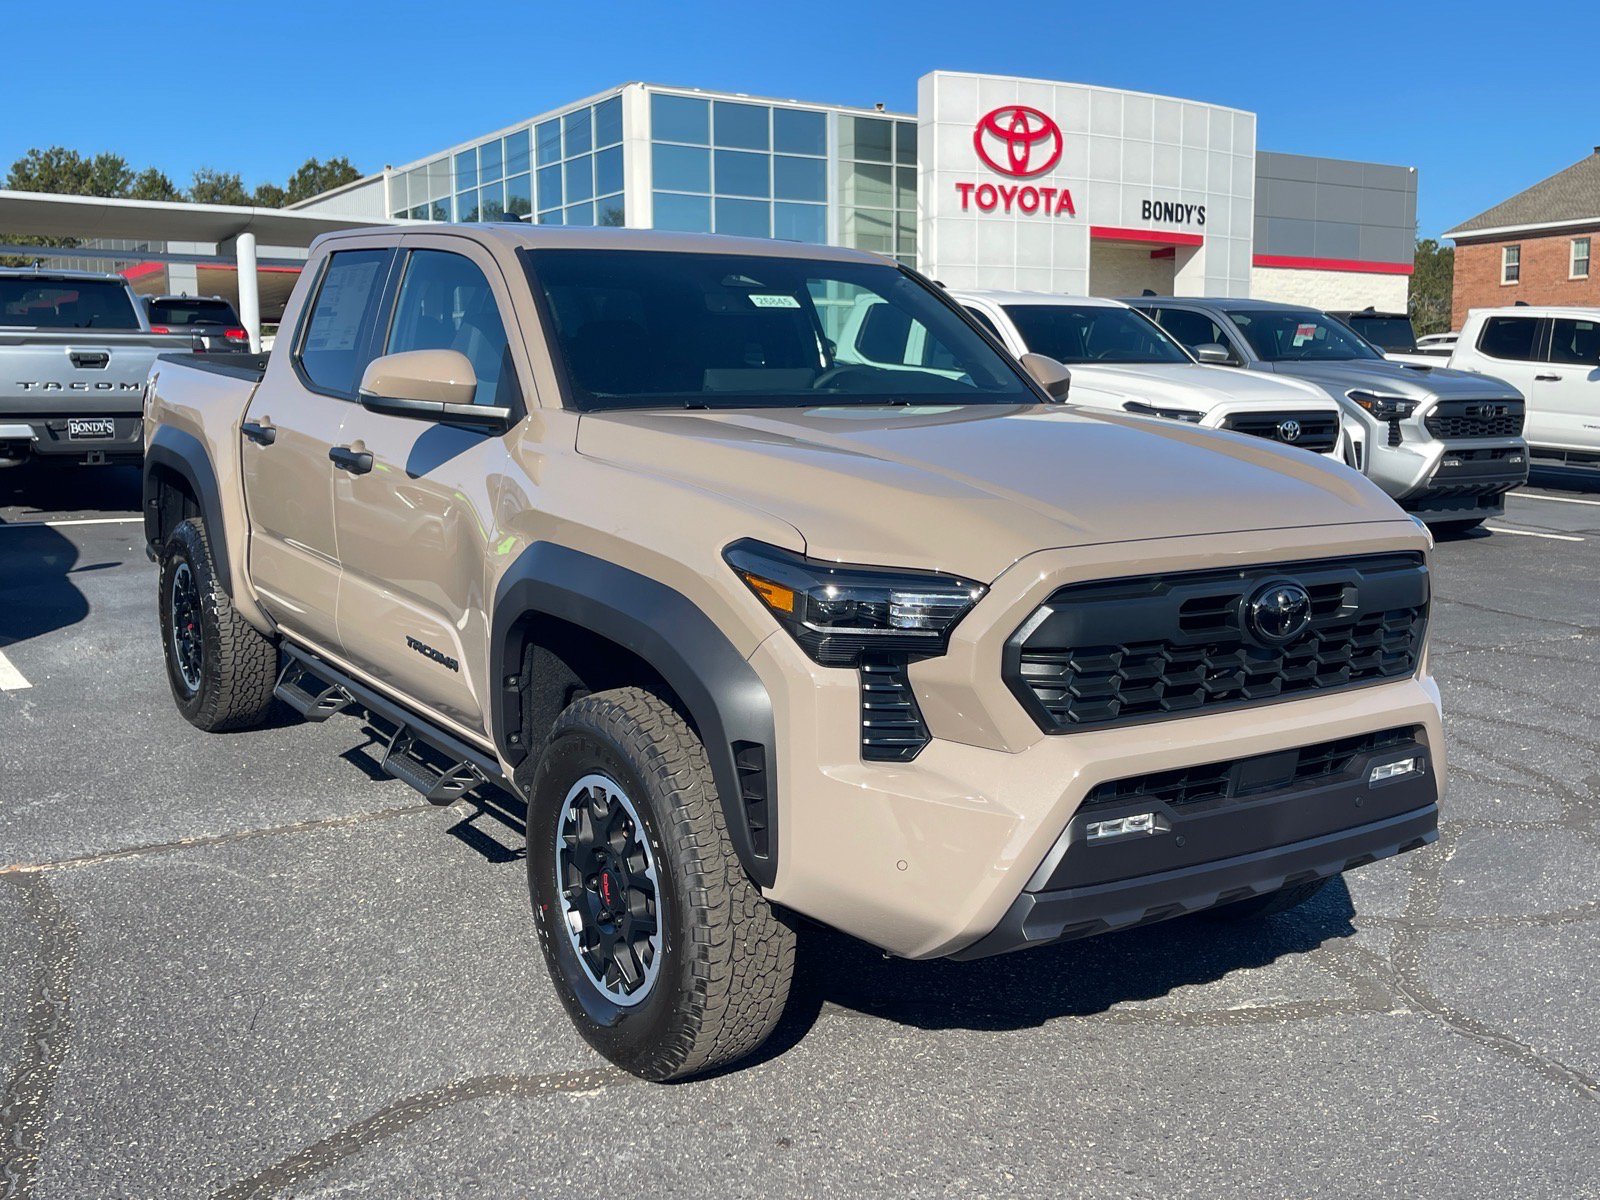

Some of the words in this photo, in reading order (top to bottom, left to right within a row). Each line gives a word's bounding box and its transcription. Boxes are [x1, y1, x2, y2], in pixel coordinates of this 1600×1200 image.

[955, 182, 1076, 216] TOYOTA
[1141, 200, 1206, 226] BONDY'S
[71, 420, 113, 434] BONDY'S
[406, 635, 459, 673] TACOMA
